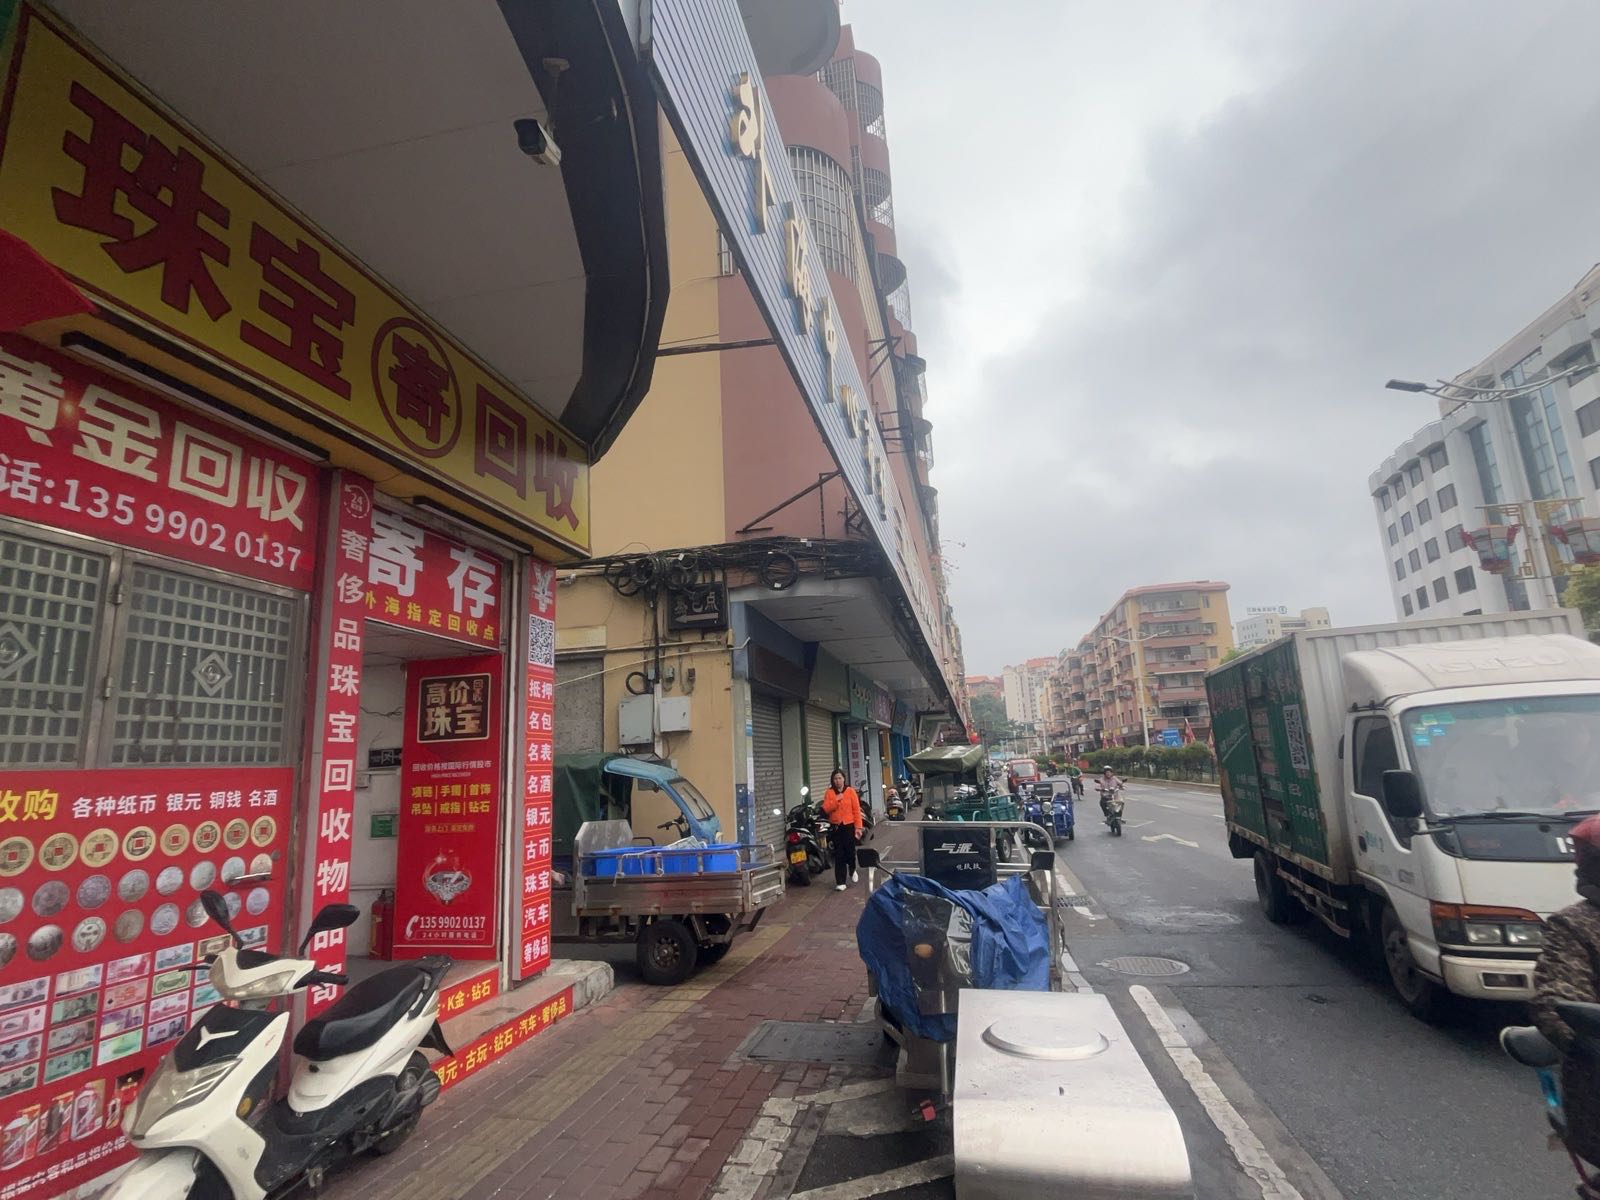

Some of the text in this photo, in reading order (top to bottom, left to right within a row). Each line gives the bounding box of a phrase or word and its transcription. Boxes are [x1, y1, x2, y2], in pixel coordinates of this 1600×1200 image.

[0, 346, 307, 532] 黄金回收
[145, 503, 226, 552] 9902
[234, 531, 302, 572] 0137
[426, 681, 469, 706] 高价
[529, 679, 553, 699] 抵押
[424, 704, 482, 736] 珠宝
[528, 711, 552, 730] 名包
[528, 743, 552, 761] 名表
[527, 774, 551, 794] 名酒
[72, 794, 157, 820] 各种纸币
[166, 793, 202, 813] 银元
[209, 791, 242, 809] 铜钱
[248, 789, 278, 807] 名酒
[469, 801, 490, 813] 钻石
[526, 807, 550, 826] 银元
[525, 837, 549, 860] 古币
[524, 871, 549, 893] 珠宝
[420, 916, 486, 928] 135 9902 0137
[524, 903, 549, 928] 汽车
[524, 936, 548, 963] 奢侈品
